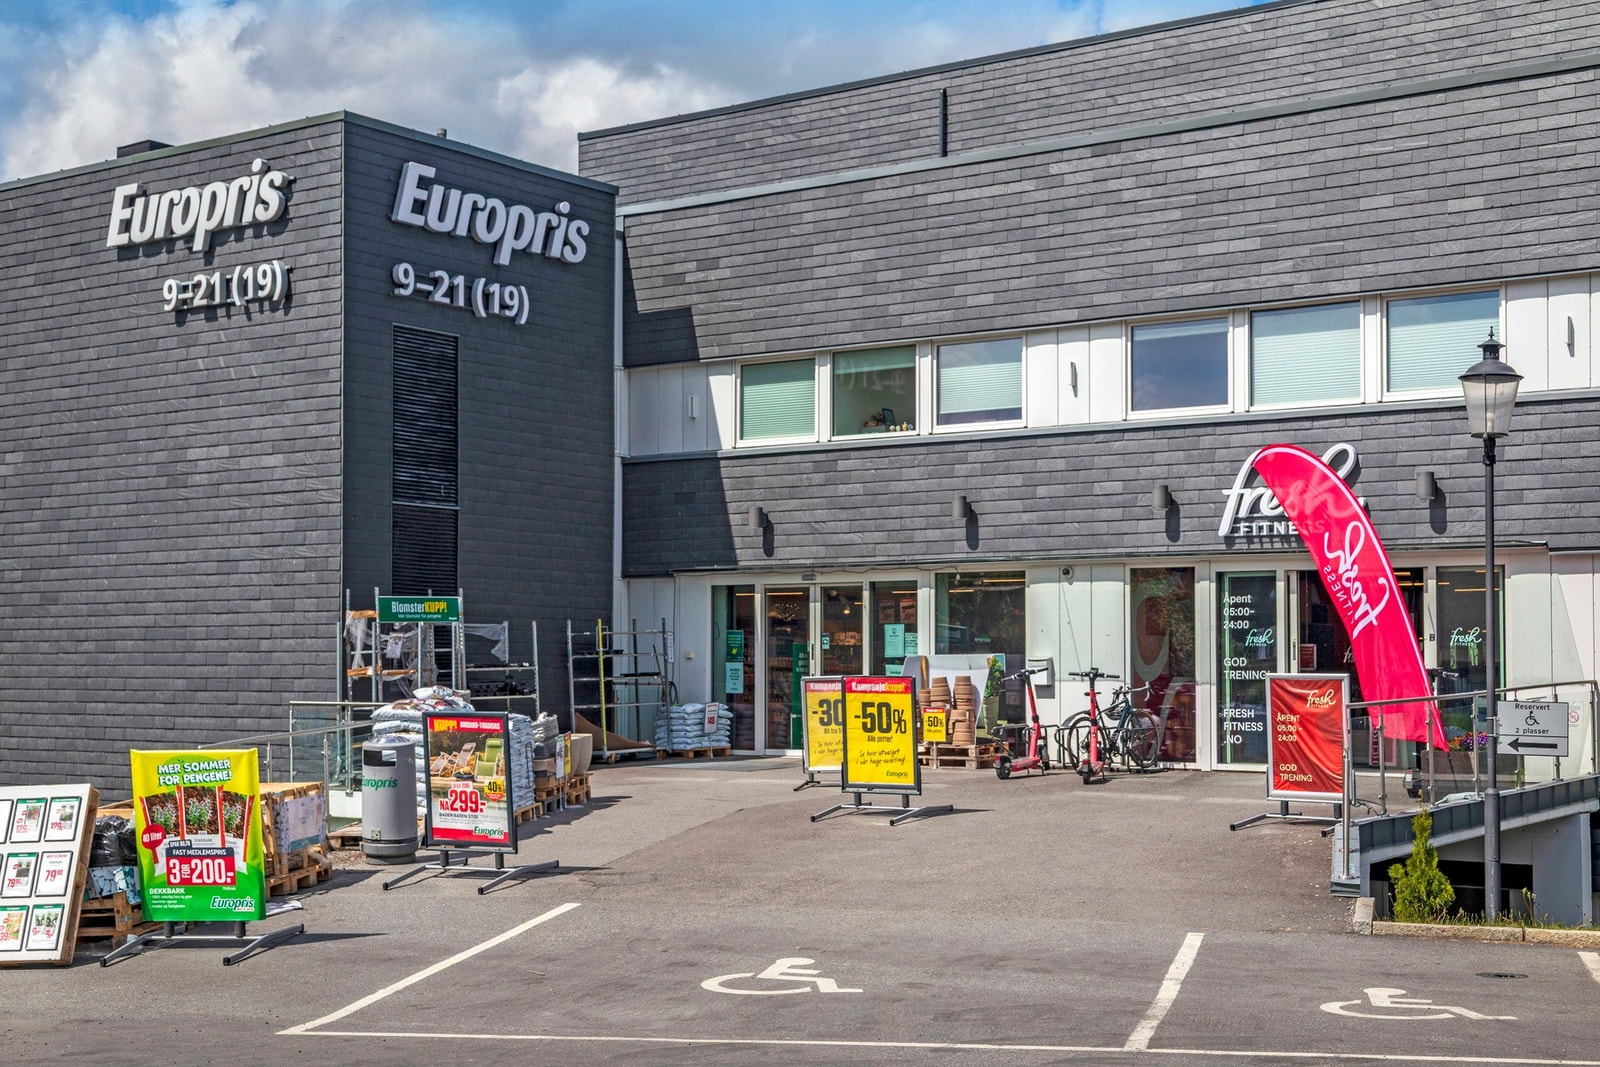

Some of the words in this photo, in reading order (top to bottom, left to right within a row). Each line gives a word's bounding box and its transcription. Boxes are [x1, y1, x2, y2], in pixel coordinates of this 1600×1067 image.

[107, 158, 290, 251] Europris
[391, 161, 590, 265] Europris
[163, 275, 221, 311] 9–21
[231, 260, 287, 307] (19)
[394, 262, 466, 307] 9–21
[472, 277, 530, 324] (19)
[1223, 591, 1252, 605] Åpent
[392, 601, 447, 613] BlomsterKUPP!
[1223, 620, 1249, 629] 24:00
[1245, 628, 1275, 647] fresh
[1450, 626, 1482, 646] fresh
[1223, 657, 1247, 667] GOD
[1223, 670, 1270, 680] TRENING
[810, 682, 842, 691] Kampanje
[851, 682, 905, 692] Kampanjekupp!
[1306, 689, 1336, 708] fresh
[1515, 703, 1550, 711] Reservert
[812, 699, 843, 727] -30
[854, 702, 907, 734] -50%
[1223, 709, 1255, 718] FRESH
[1277, 713, 1300, 722] ÅPENT
[433, 719, 457, 732] KUPP!
[925, 716, 944, 728] -50%
[1223, 722, 1264, 731] FITNESS
[1523, 728, 1550, 736] plasser
[877, 735, 893, 743] potter!
[1224, 735, 1243, 744] .NO
[1278, 734, 1297, 742] 24:00
[827, 748, 843, 756] hage-
[878, 749, 900, 758] utvalget
[159, 763, 180, 774] MER
[184, 760, 230, 772] SOMMER
[1280, 763, 1297, 772] GOD
[160, 775, 180, 786] FOR
[182, 771, 232, 784] PENGENE!
[886, 770, 908, 778] Europris
[1280, 774, 1312, 782] TRENING
[486, 781, 503, 792] -40%
[151, 832, 162, 841] liter
[474, 826, 504, 837] Europris
[169, 858, 180, 884] 3
[182, 864, 190, 878] FOR
[211, 896, 255, 911] Europris
